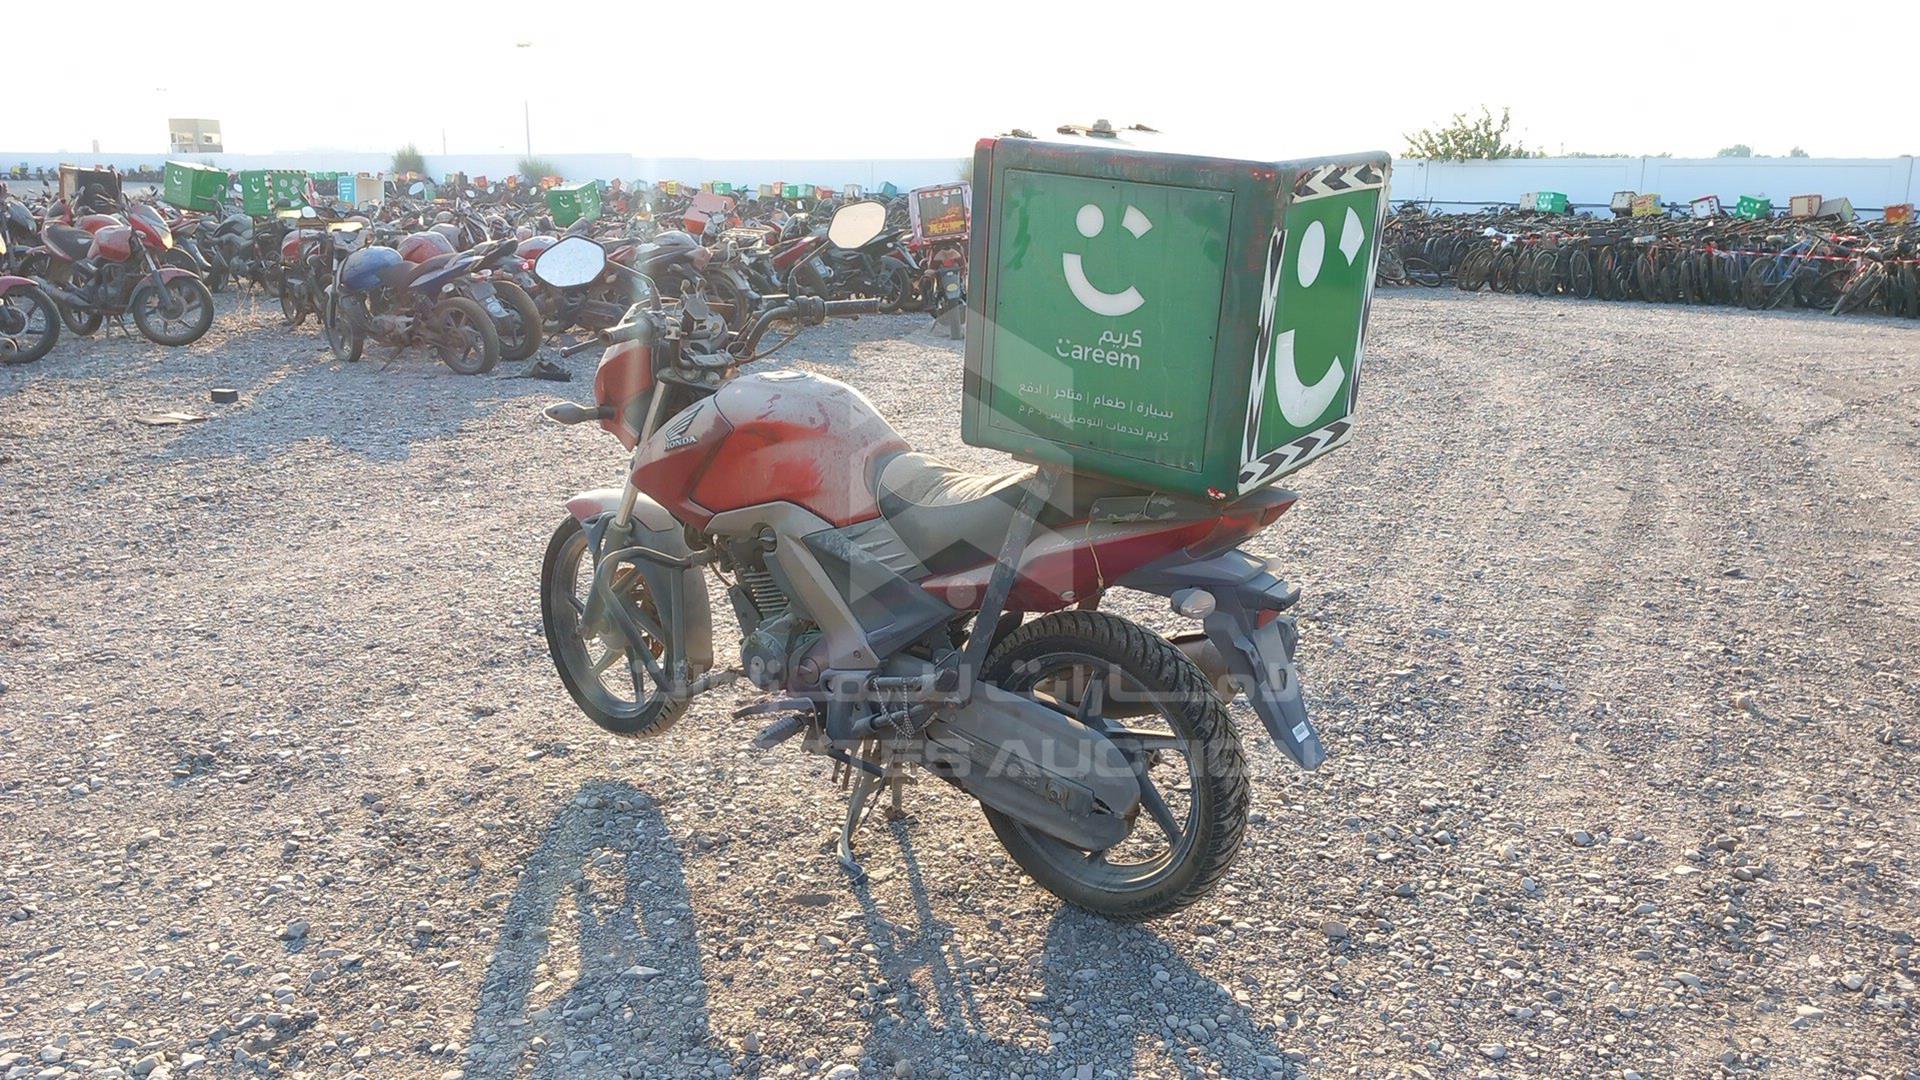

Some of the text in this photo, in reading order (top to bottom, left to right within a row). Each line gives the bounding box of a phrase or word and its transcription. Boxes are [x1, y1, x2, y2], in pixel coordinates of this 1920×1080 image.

[1098, 329, 1142, 350] كريم
[1055, 338, 1140, 370] Careem
[1053, 385, 1083, 402] متاجر
[1093, 394, 1126, 410] طعام
[1136, 401, 1174, 418] سيارة
[664, 435, 698, 452] HONDA
[1145, 430, 1169, 442] كريم
